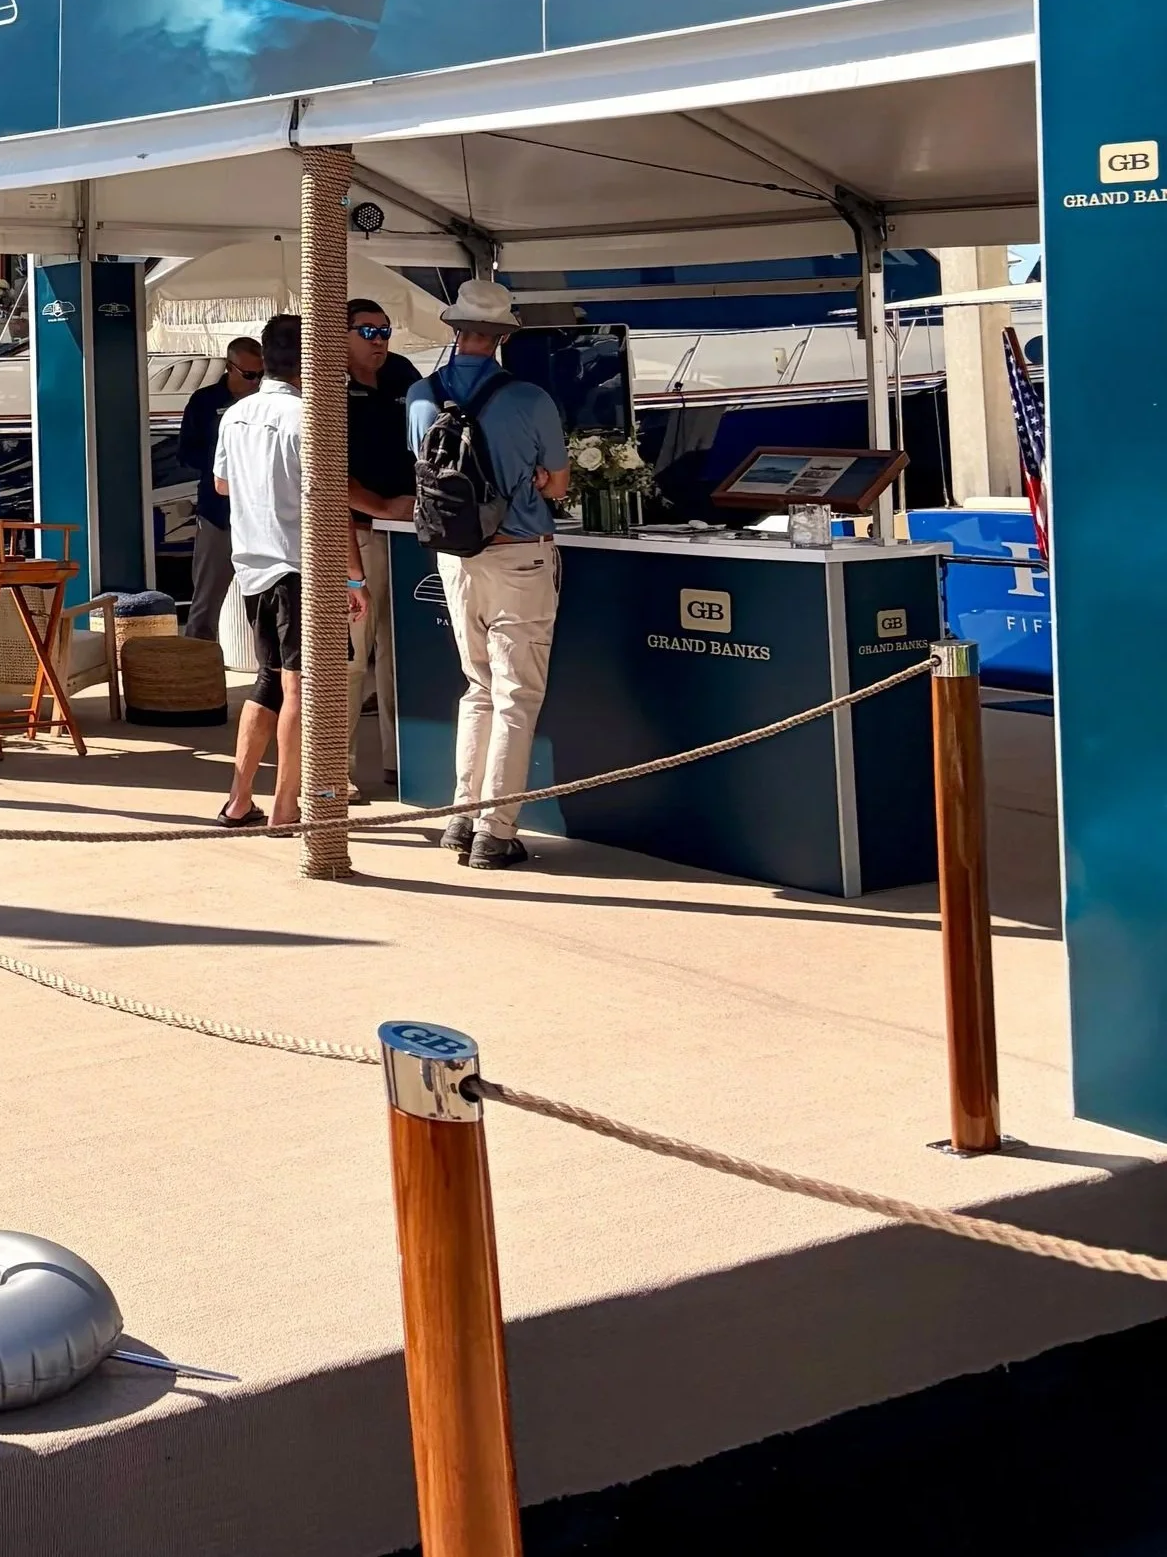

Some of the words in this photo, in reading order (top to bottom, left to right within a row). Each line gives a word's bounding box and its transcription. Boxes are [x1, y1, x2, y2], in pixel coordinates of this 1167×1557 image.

[1108, 153, 1149, 171] GB
[1063, 191, 1129, 207] GRAND
[687, 601, 724, 620] GB
[882, 617, 902, 630] GB
[1006, 616, 1051, 633] FIF
[647, 634, 706, 653] GRAND
[710, 640, 771, 661] BANKS
[858, 644, 894, 655] GRAND
[895, 639, 929, 651] BANKS
[392, 1024, 468, 1054] GB
